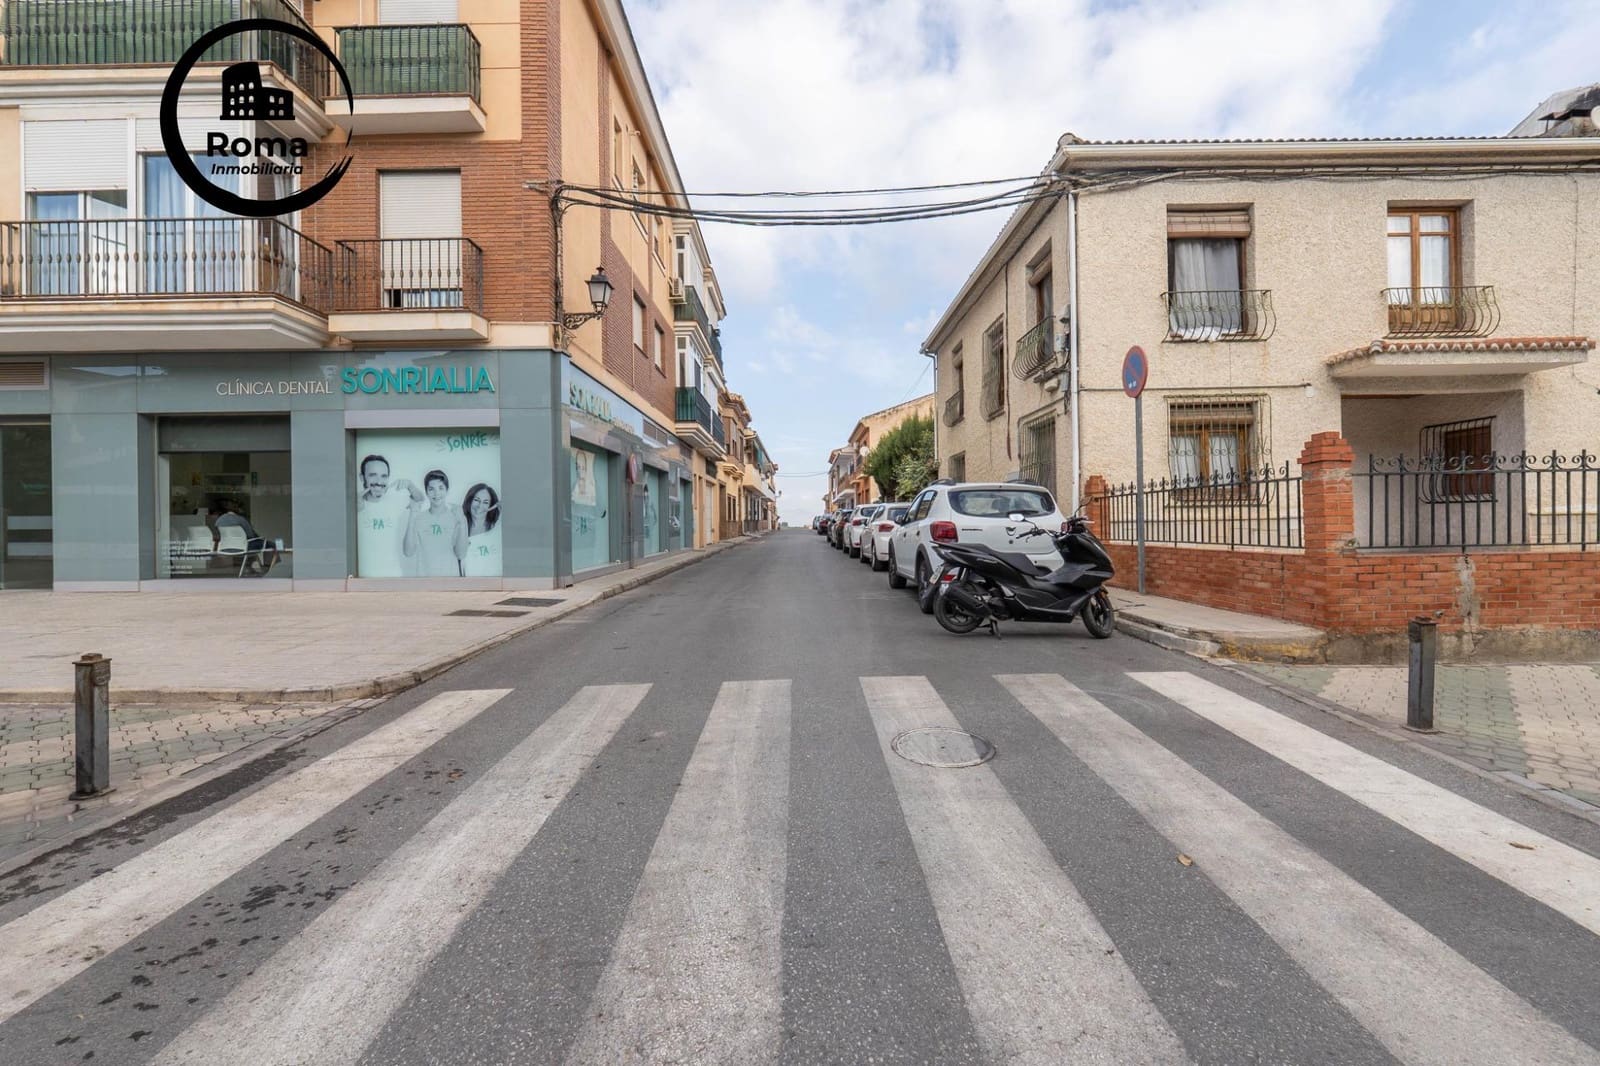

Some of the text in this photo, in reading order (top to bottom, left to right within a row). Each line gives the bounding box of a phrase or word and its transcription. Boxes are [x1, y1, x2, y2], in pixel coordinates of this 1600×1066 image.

[215, 366, 496, 396] CLÍNICA DENTAL SONRIALIA
[372, 519, 385, 531] PA
[431, 524, 443, 535] TA
[477, 545, 489, 556] TA
